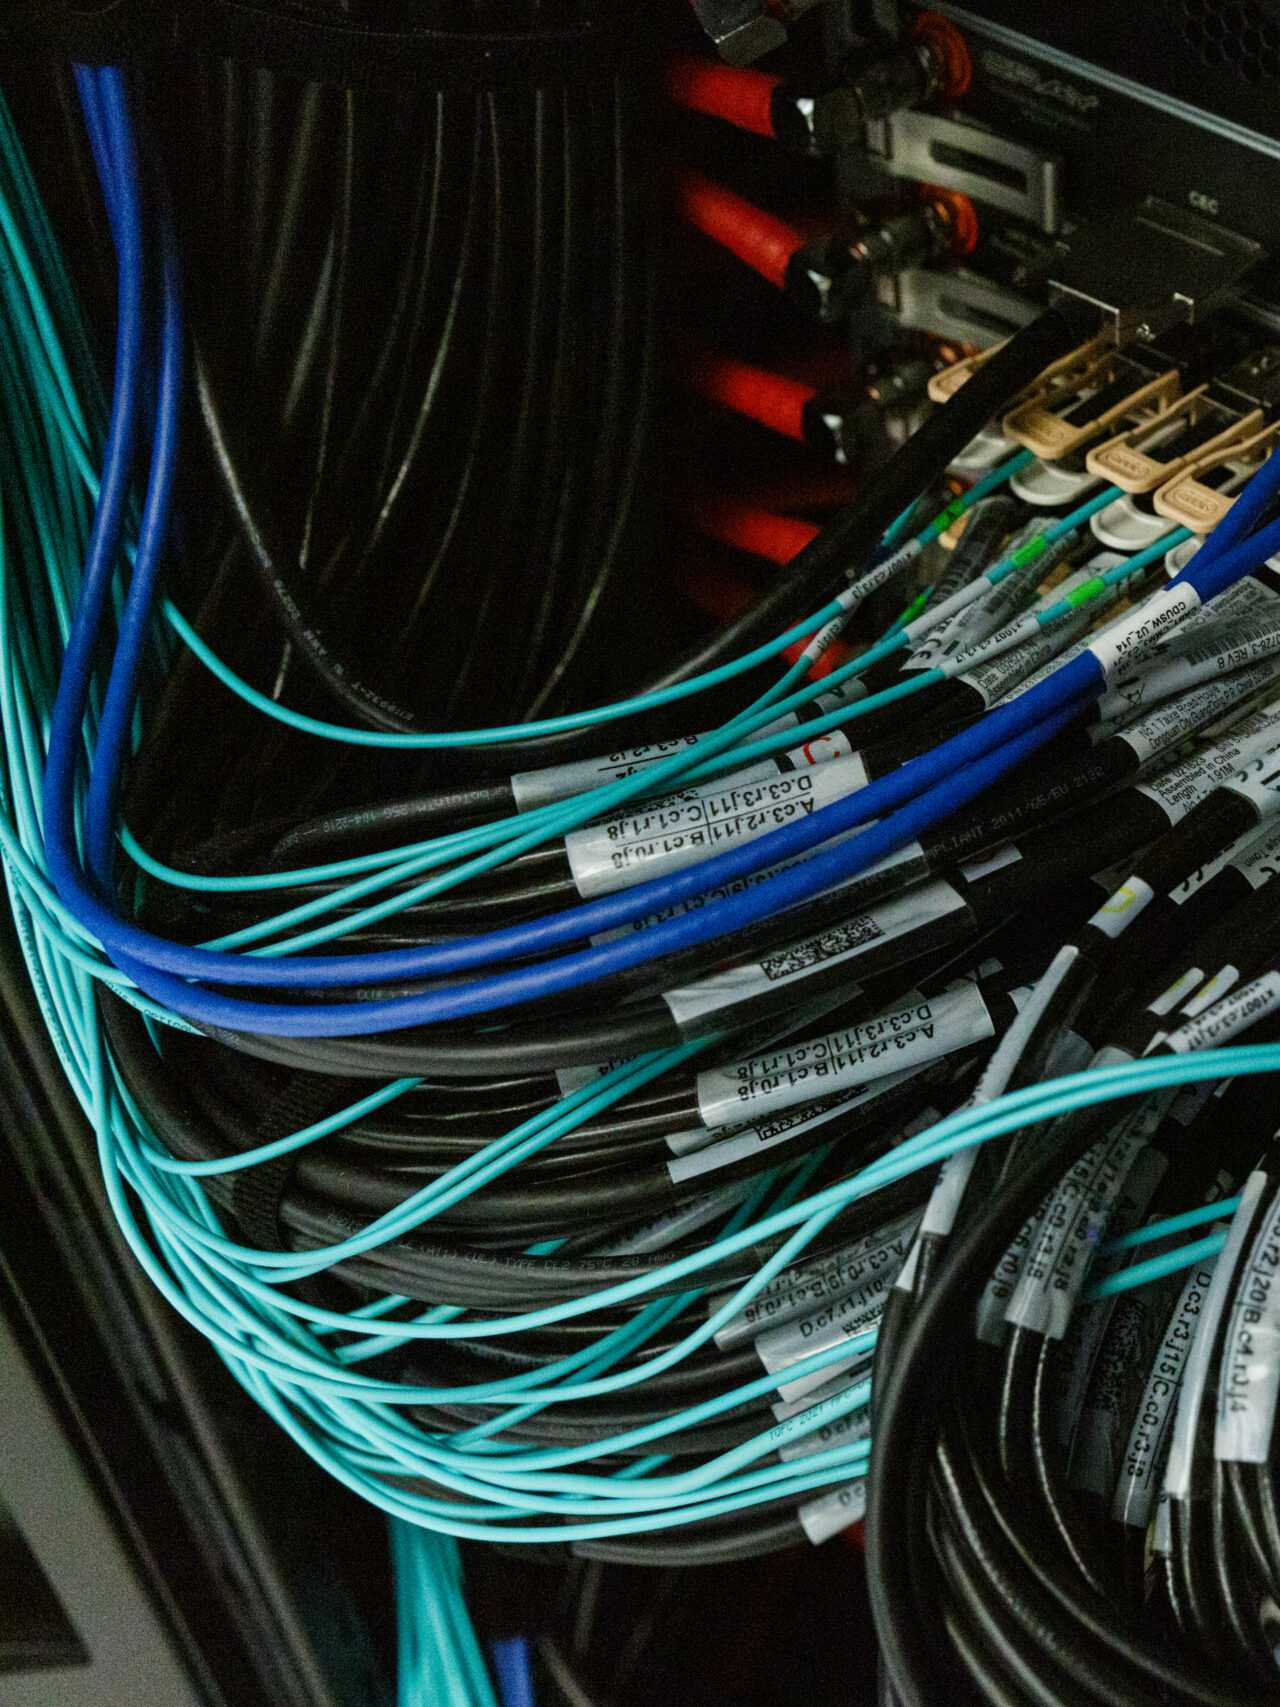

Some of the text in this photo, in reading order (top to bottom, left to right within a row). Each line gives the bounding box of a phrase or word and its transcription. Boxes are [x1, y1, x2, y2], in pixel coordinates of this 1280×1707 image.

[1114, 598, 1185, 652] CDUSW_U2_J14
[977, 669, 999, 690] Date
[985, 663, 1026, 699] Assembled
[1029, 643, 1053, 664] China
[1216, 657, 1225, 668] B
[1226, 648, 1248, 664] REV
[1158, 765, 1206, 799] Assembled
[1214, 746, 1239, 766] China
[1166, 762, 1234, 806] Length 1.91M
[605, 770, 811, 844] D.c3.r3.j11 C.c1.r1.j8
[1243, 848, 1267, 867] Town
[736, 1004, 931, 1081] D.c3.r3.j11 C.c1.r1.j8
[1158, 1271, 1211, 1375] D.c3.r3.j15
